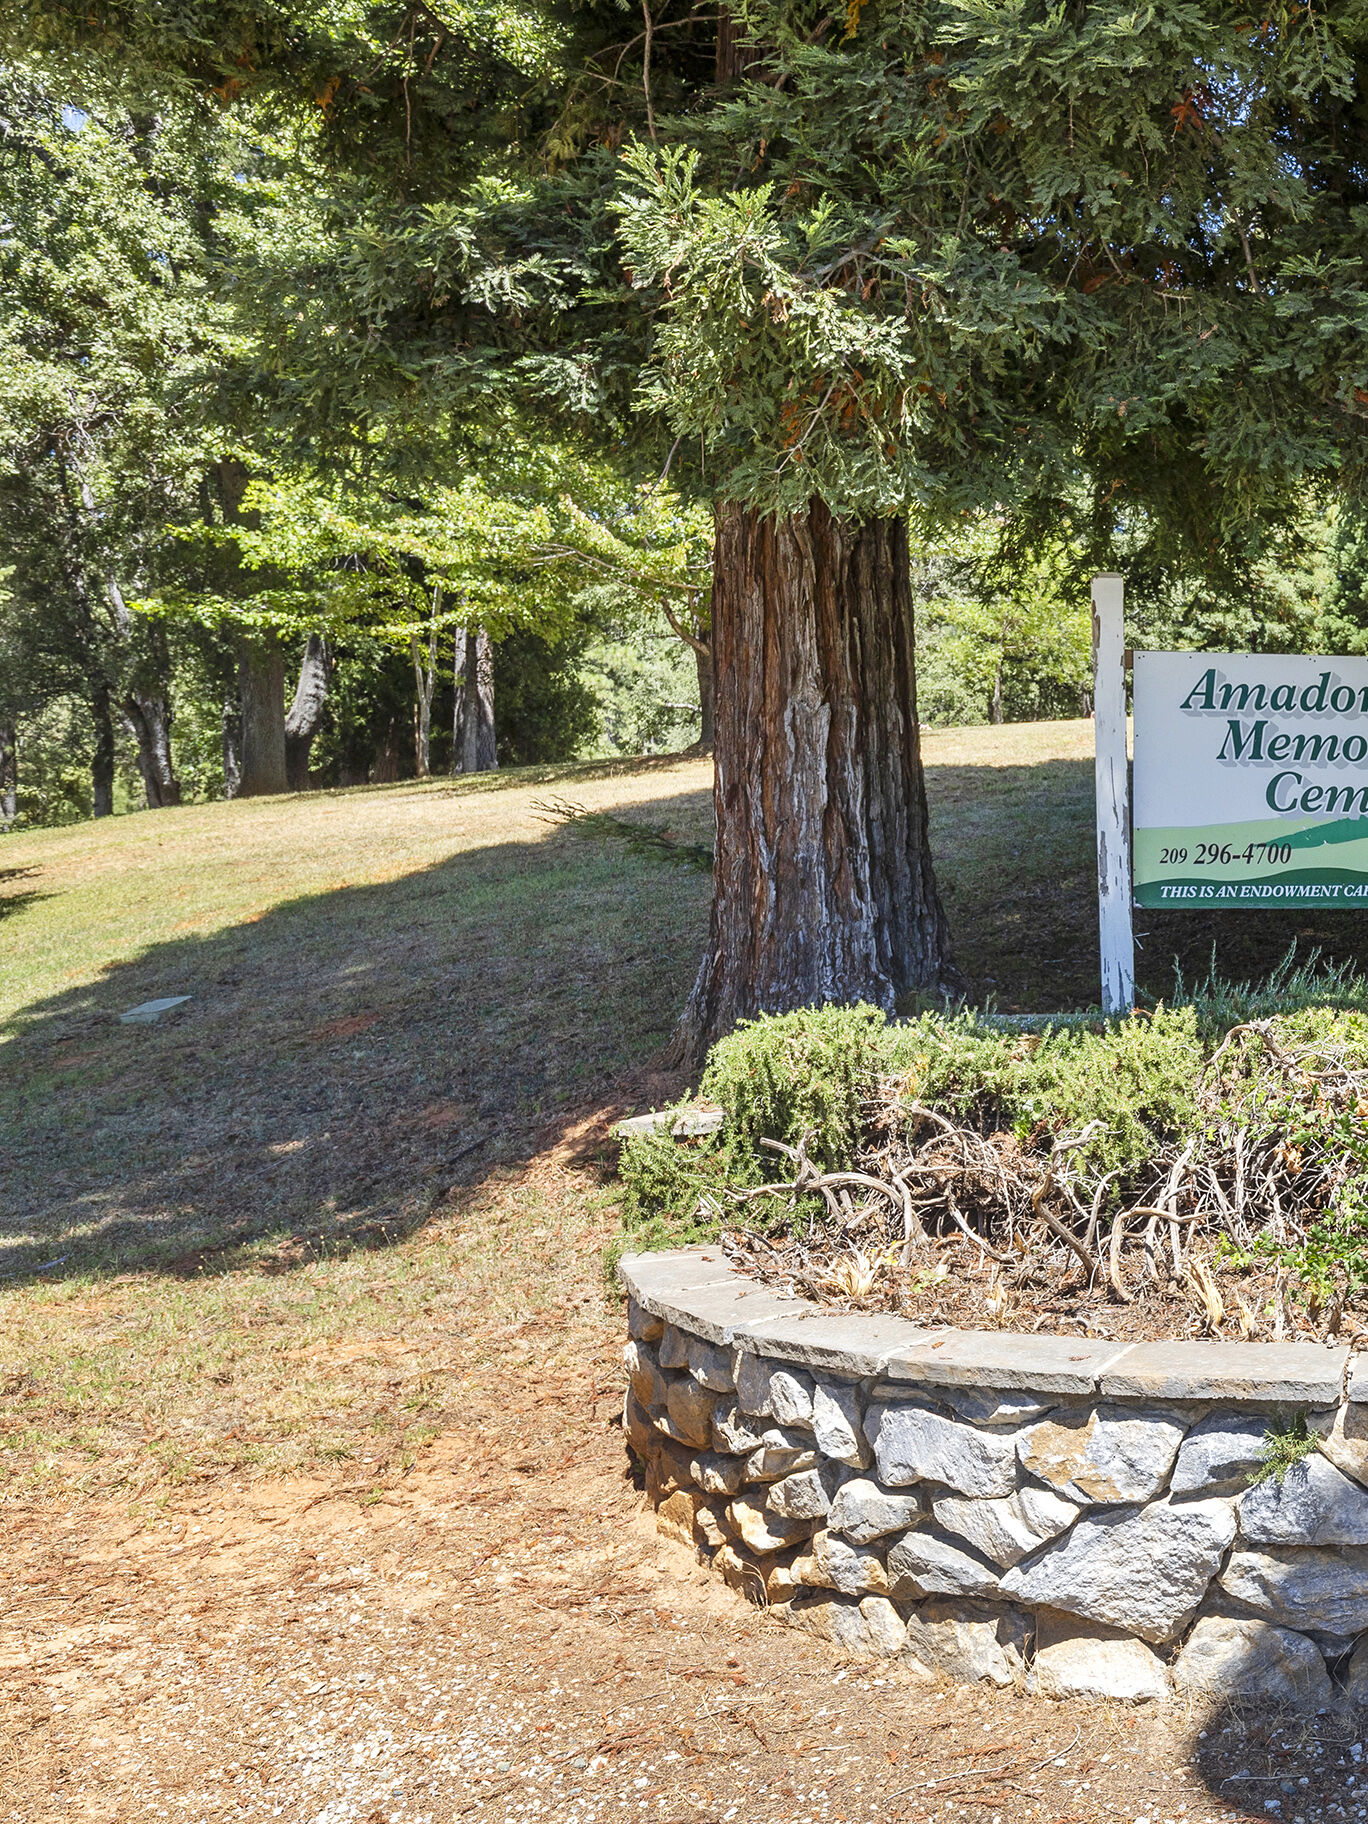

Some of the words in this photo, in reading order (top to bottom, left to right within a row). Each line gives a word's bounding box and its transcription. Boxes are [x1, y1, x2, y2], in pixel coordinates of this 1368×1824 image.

[1159, 848, 1188, 864] 209
[1193, 843, 1292, 865] 296-4700
[1160, 885, 1197, 898] THIS
[1199, 885, 1214, 898] IS
[1215, 885, 1237, 898] AN
[1240, 885, 1342, 898] ENDOWMENT
